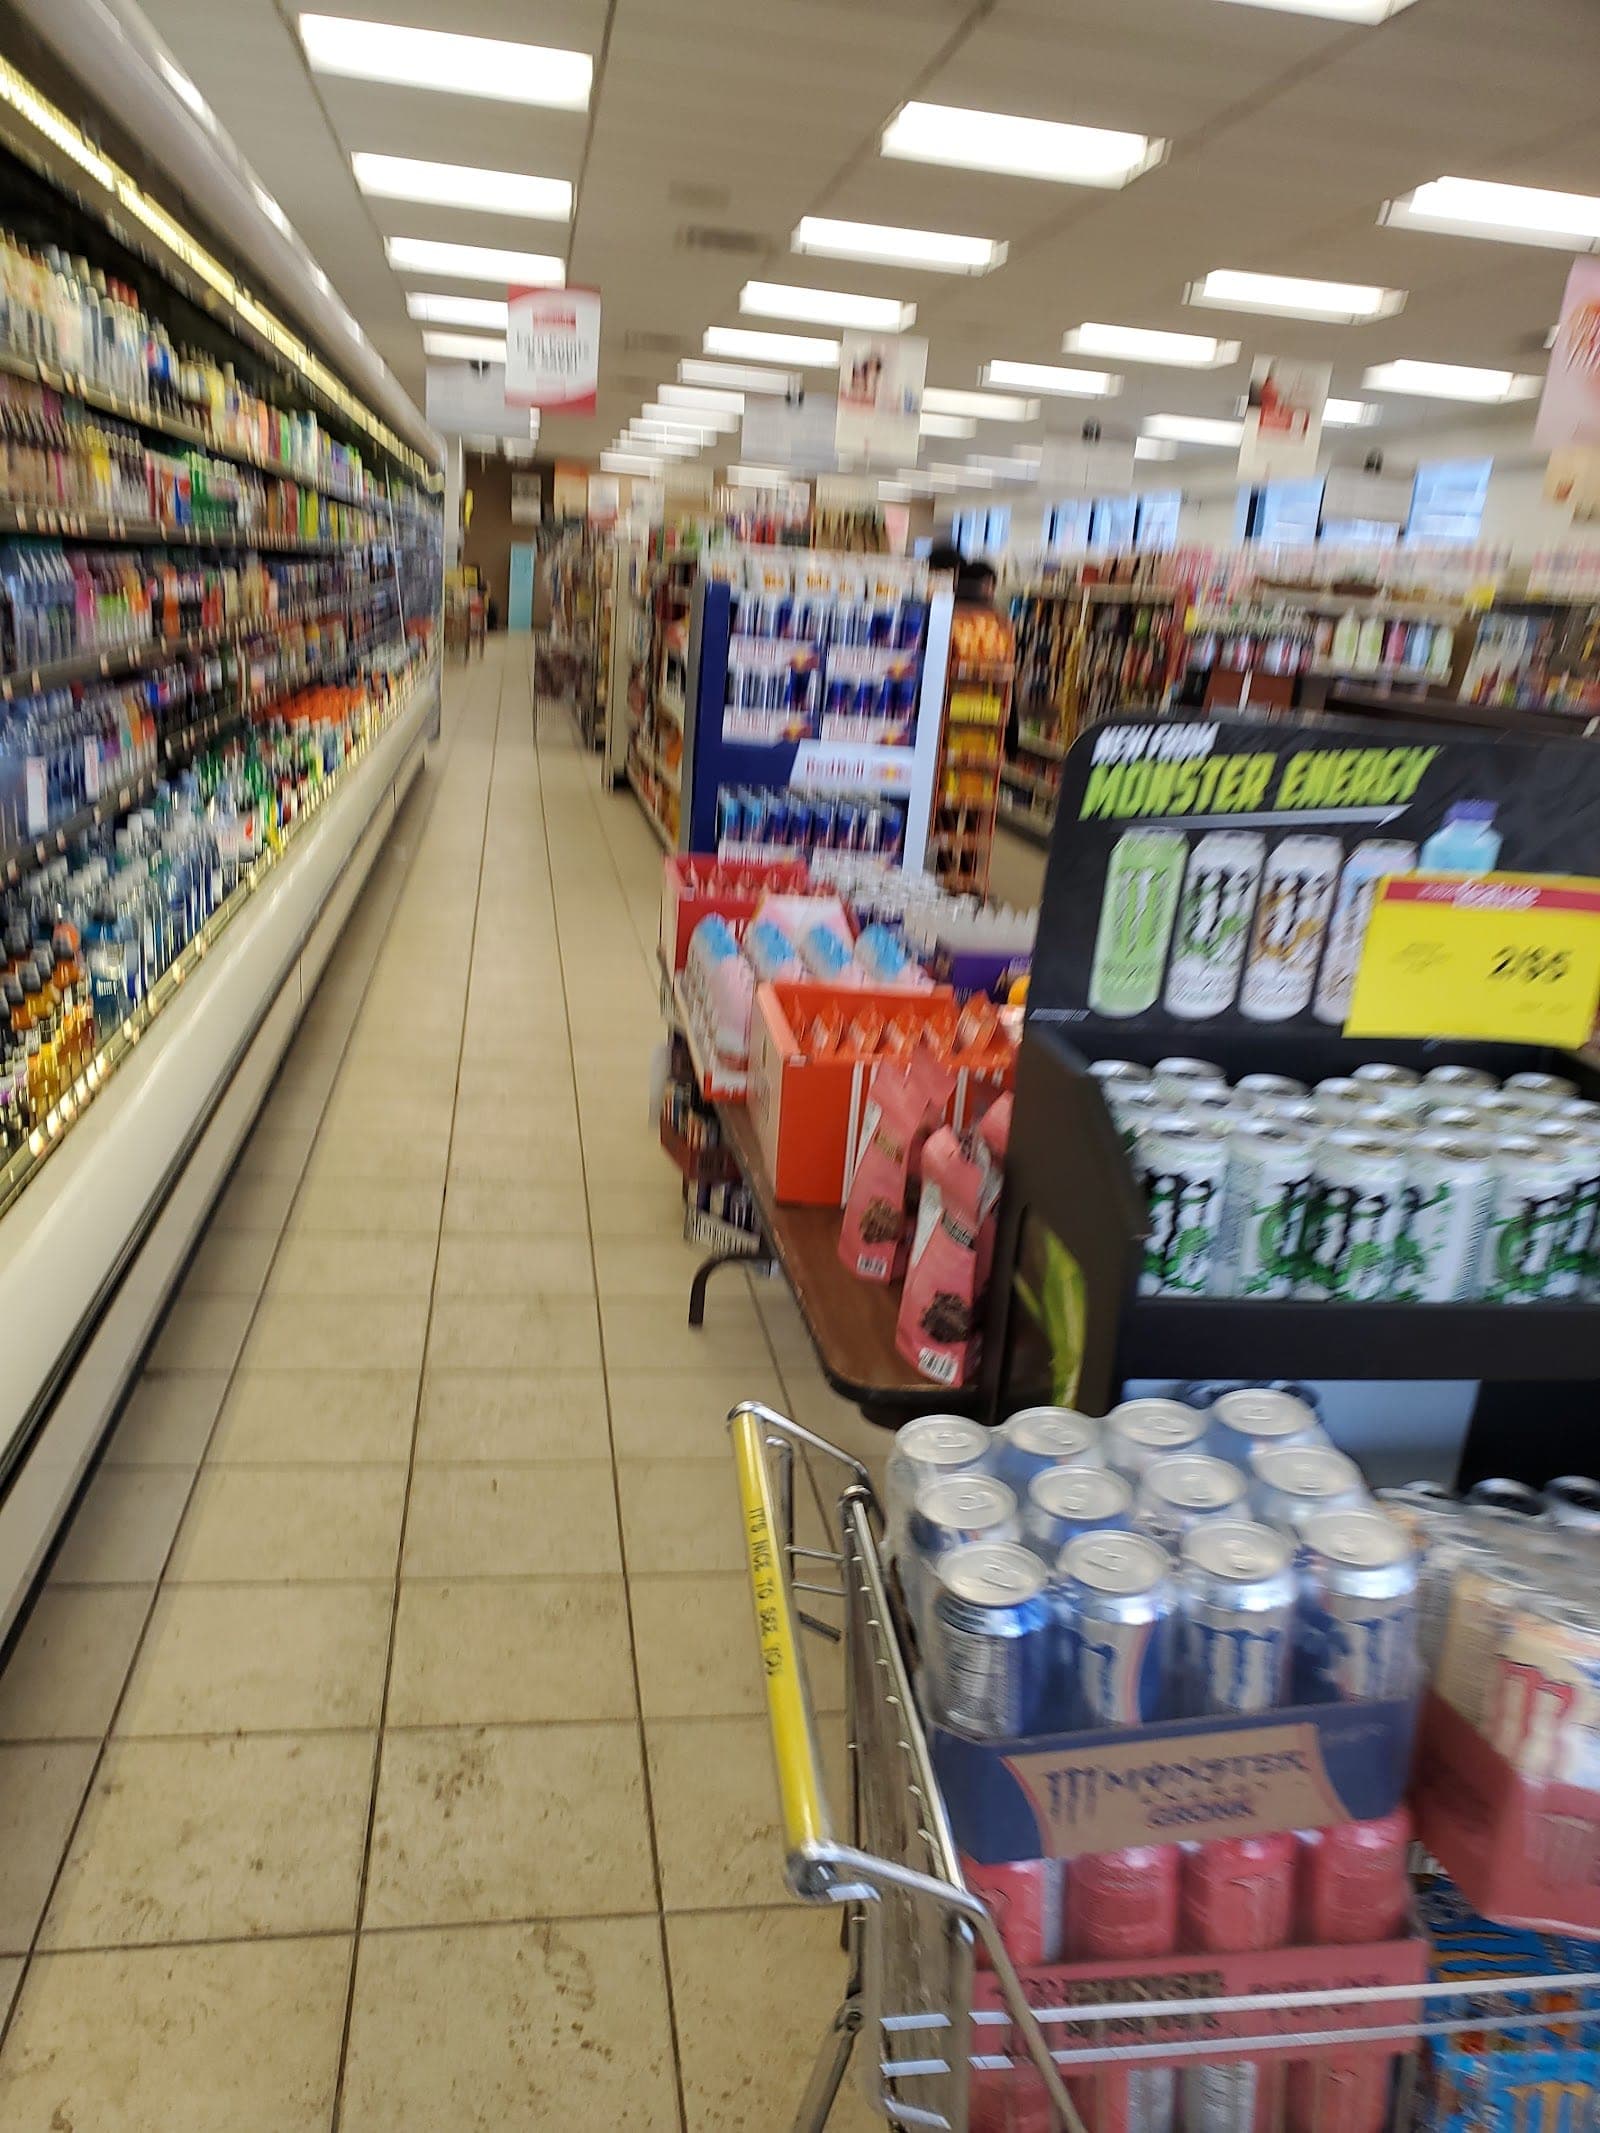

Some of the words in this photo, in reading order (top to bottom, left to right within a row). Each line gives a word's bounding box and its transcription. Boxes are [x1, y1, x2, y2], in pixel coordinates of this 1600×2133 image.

[1078, 752, 1278, 821] MONSTER
[1272, 745, 1444, 811] ENERGY
[751, 1540, 771, 1571] NICE
[756, 1577, 774, 1599] TO
